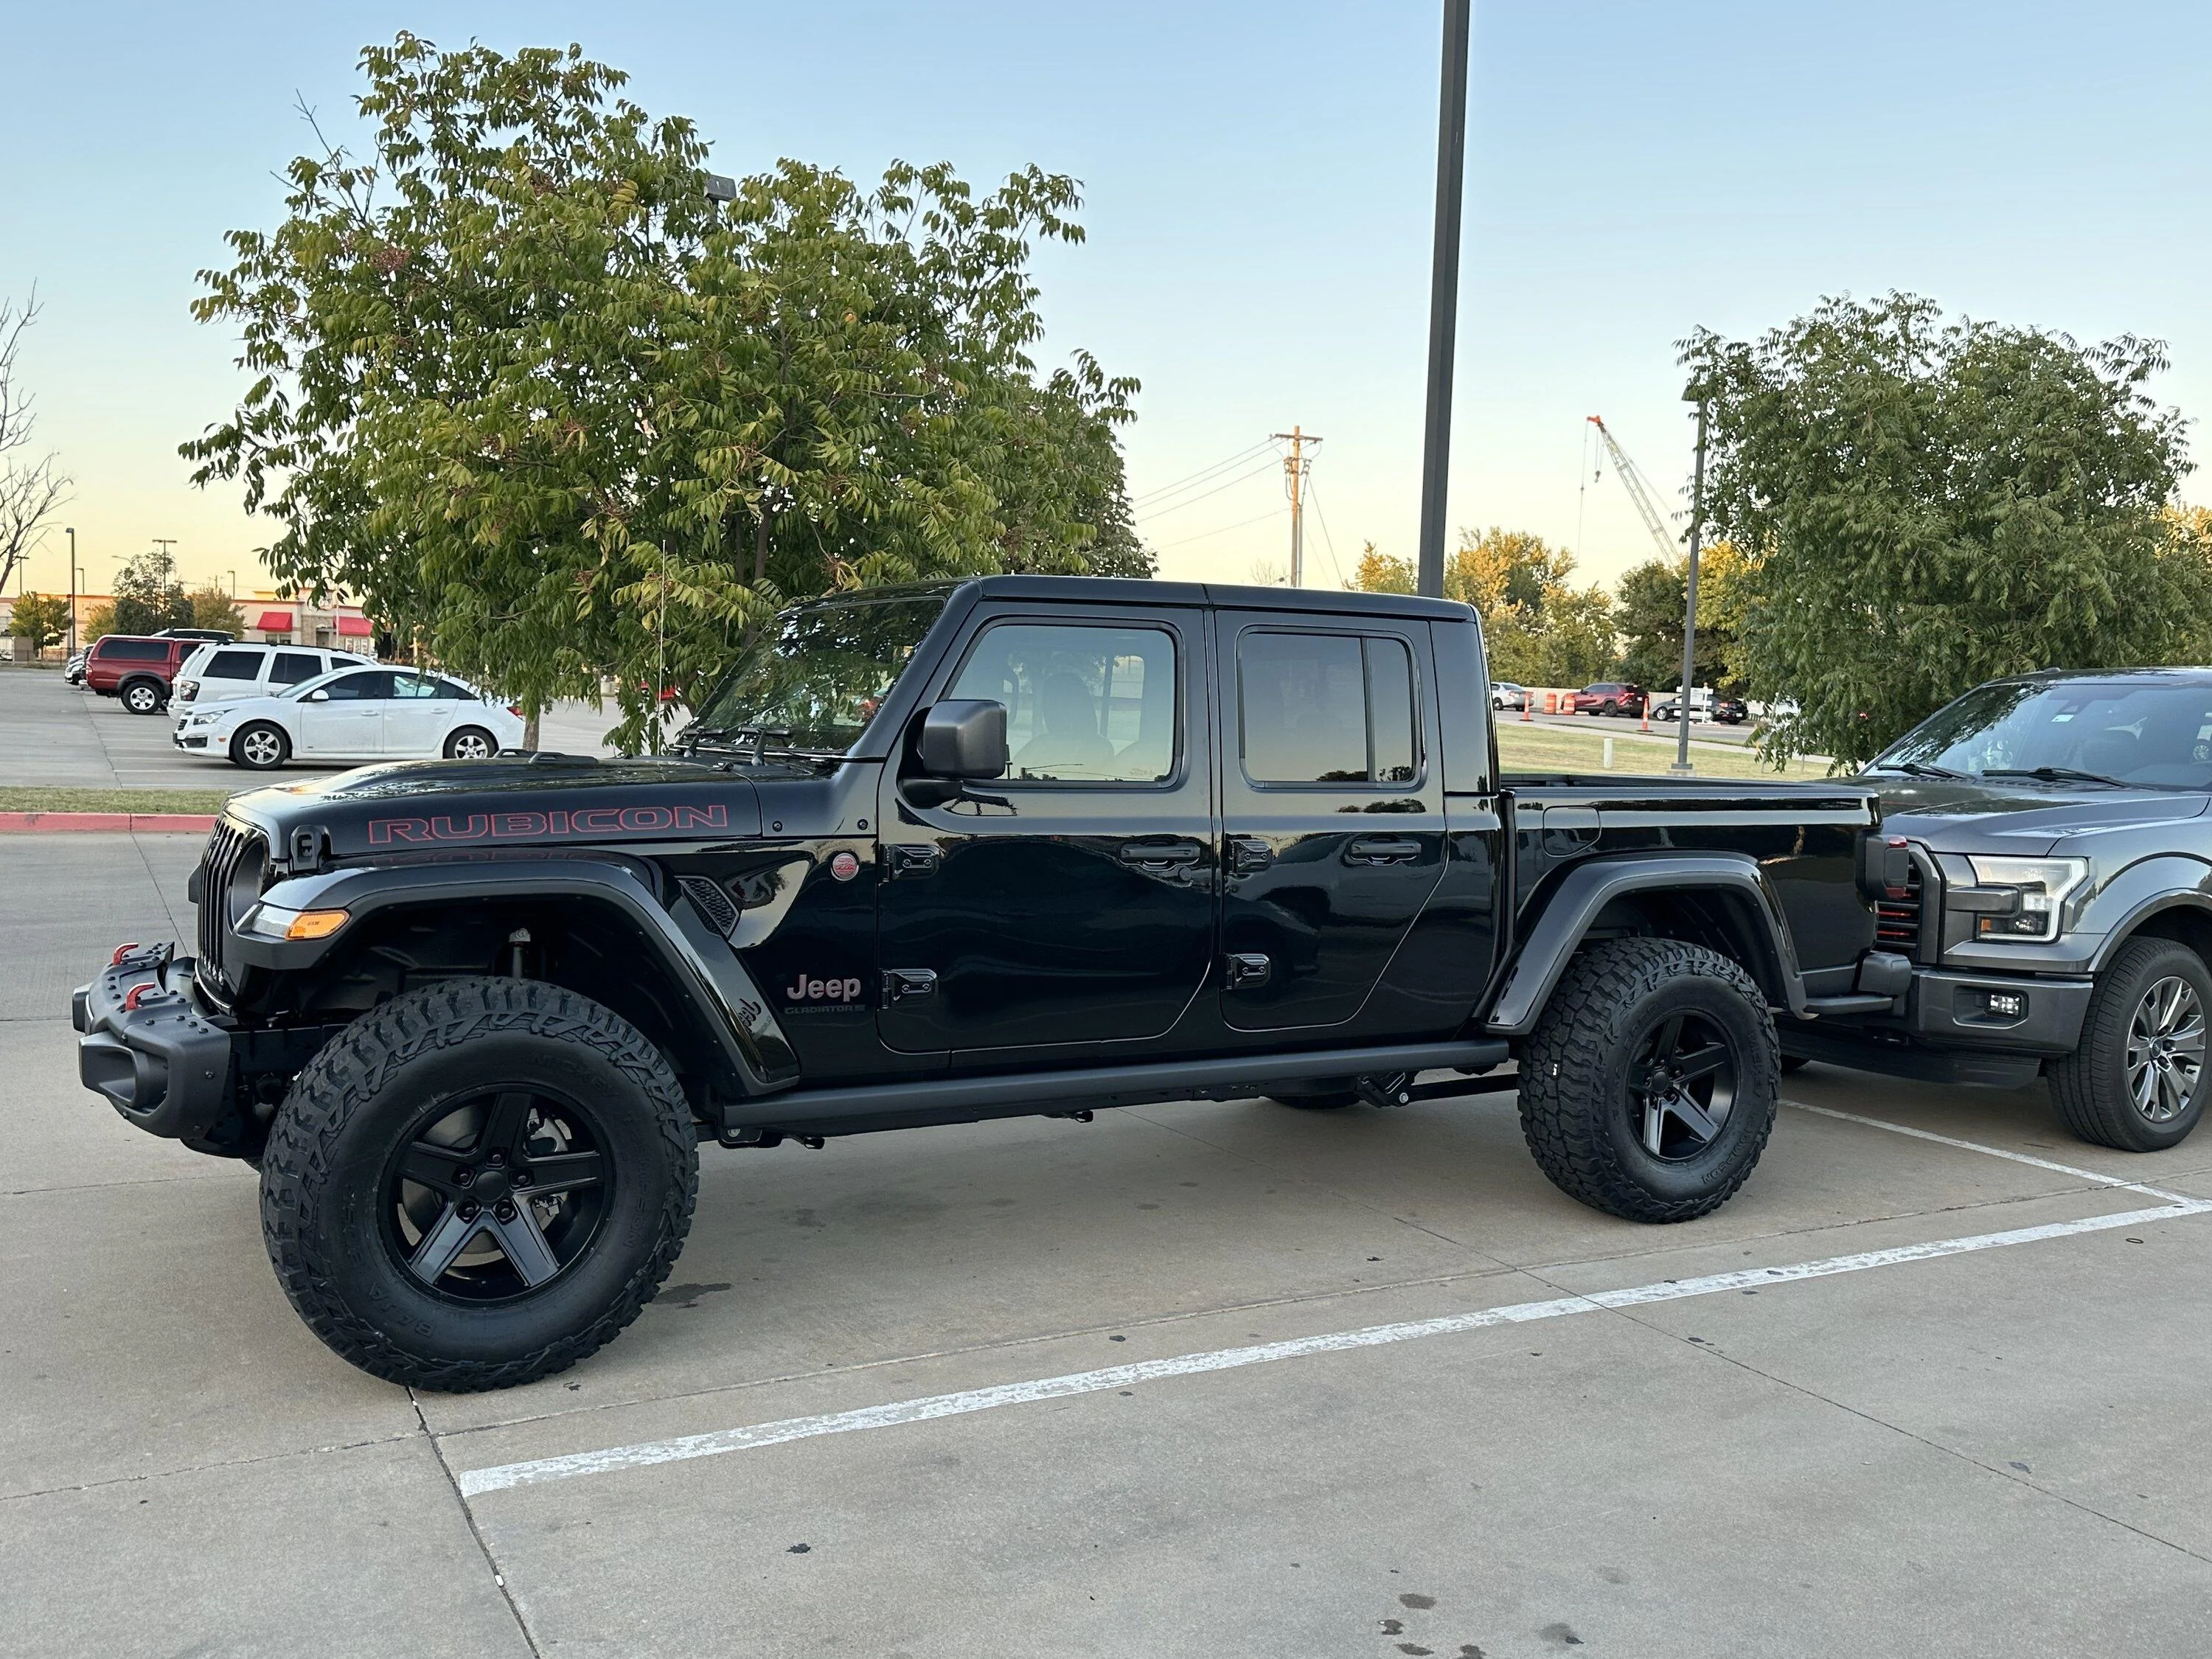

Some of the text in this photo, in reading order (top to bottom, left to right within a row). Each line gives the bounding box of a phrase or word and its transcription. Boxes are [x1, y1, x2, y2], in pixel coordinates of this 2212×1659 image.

[368, 804, 728, 844] RUBICON
[787, 974, 861, 1002] Jeep
[785, 1006, 854, 1015] GLADIATOR
